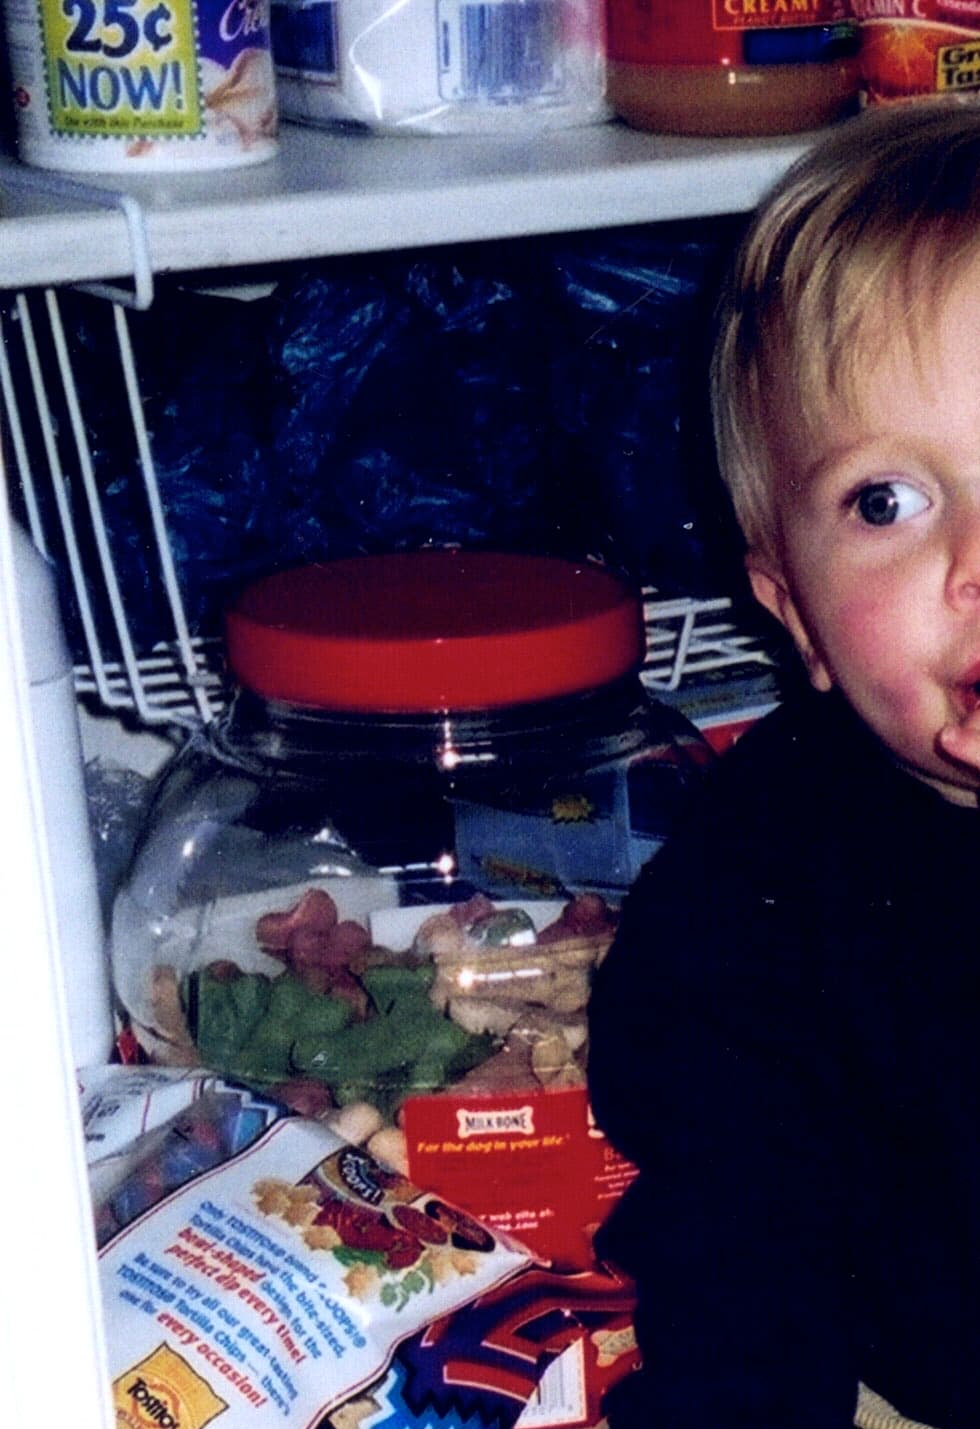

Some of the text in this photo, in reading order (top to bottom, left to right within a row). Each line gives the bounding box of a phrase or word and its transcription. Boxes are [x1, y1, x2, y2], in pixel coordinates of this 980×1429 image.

[62, 0, 173, 57] 25¢
[57, 57, 184, 111] NOW!
[417, 1142, 441, 1153] For
[442, 1141, 464, 1152] the
[466, 1141, 493, 1155] dog
[509, 1138, 541, 1151] your
[225, 1236, 256, 1260] Chips
[279, 1270, 299, 1293] the
[164, 1244, 308, 1365] perfect dip every time!
[174, 1299, 216, 1335] Tortilla
[213, 1329, 248, 1363] Chips
[261, 1280, 293, 1321] design
[290, 1316, 308, 1337] for
[304, 1336, 323, 1360] the
[118, 1289, 269, 1409] one for every occasion!
[171, 1276, 187, 1289] to
[185, 1284, 204, 1301] try
[200, 1296, 221, 1312] all
[216, 1307, 242, 1328] our
[237, 1325, 299, 1402] great-tasting
